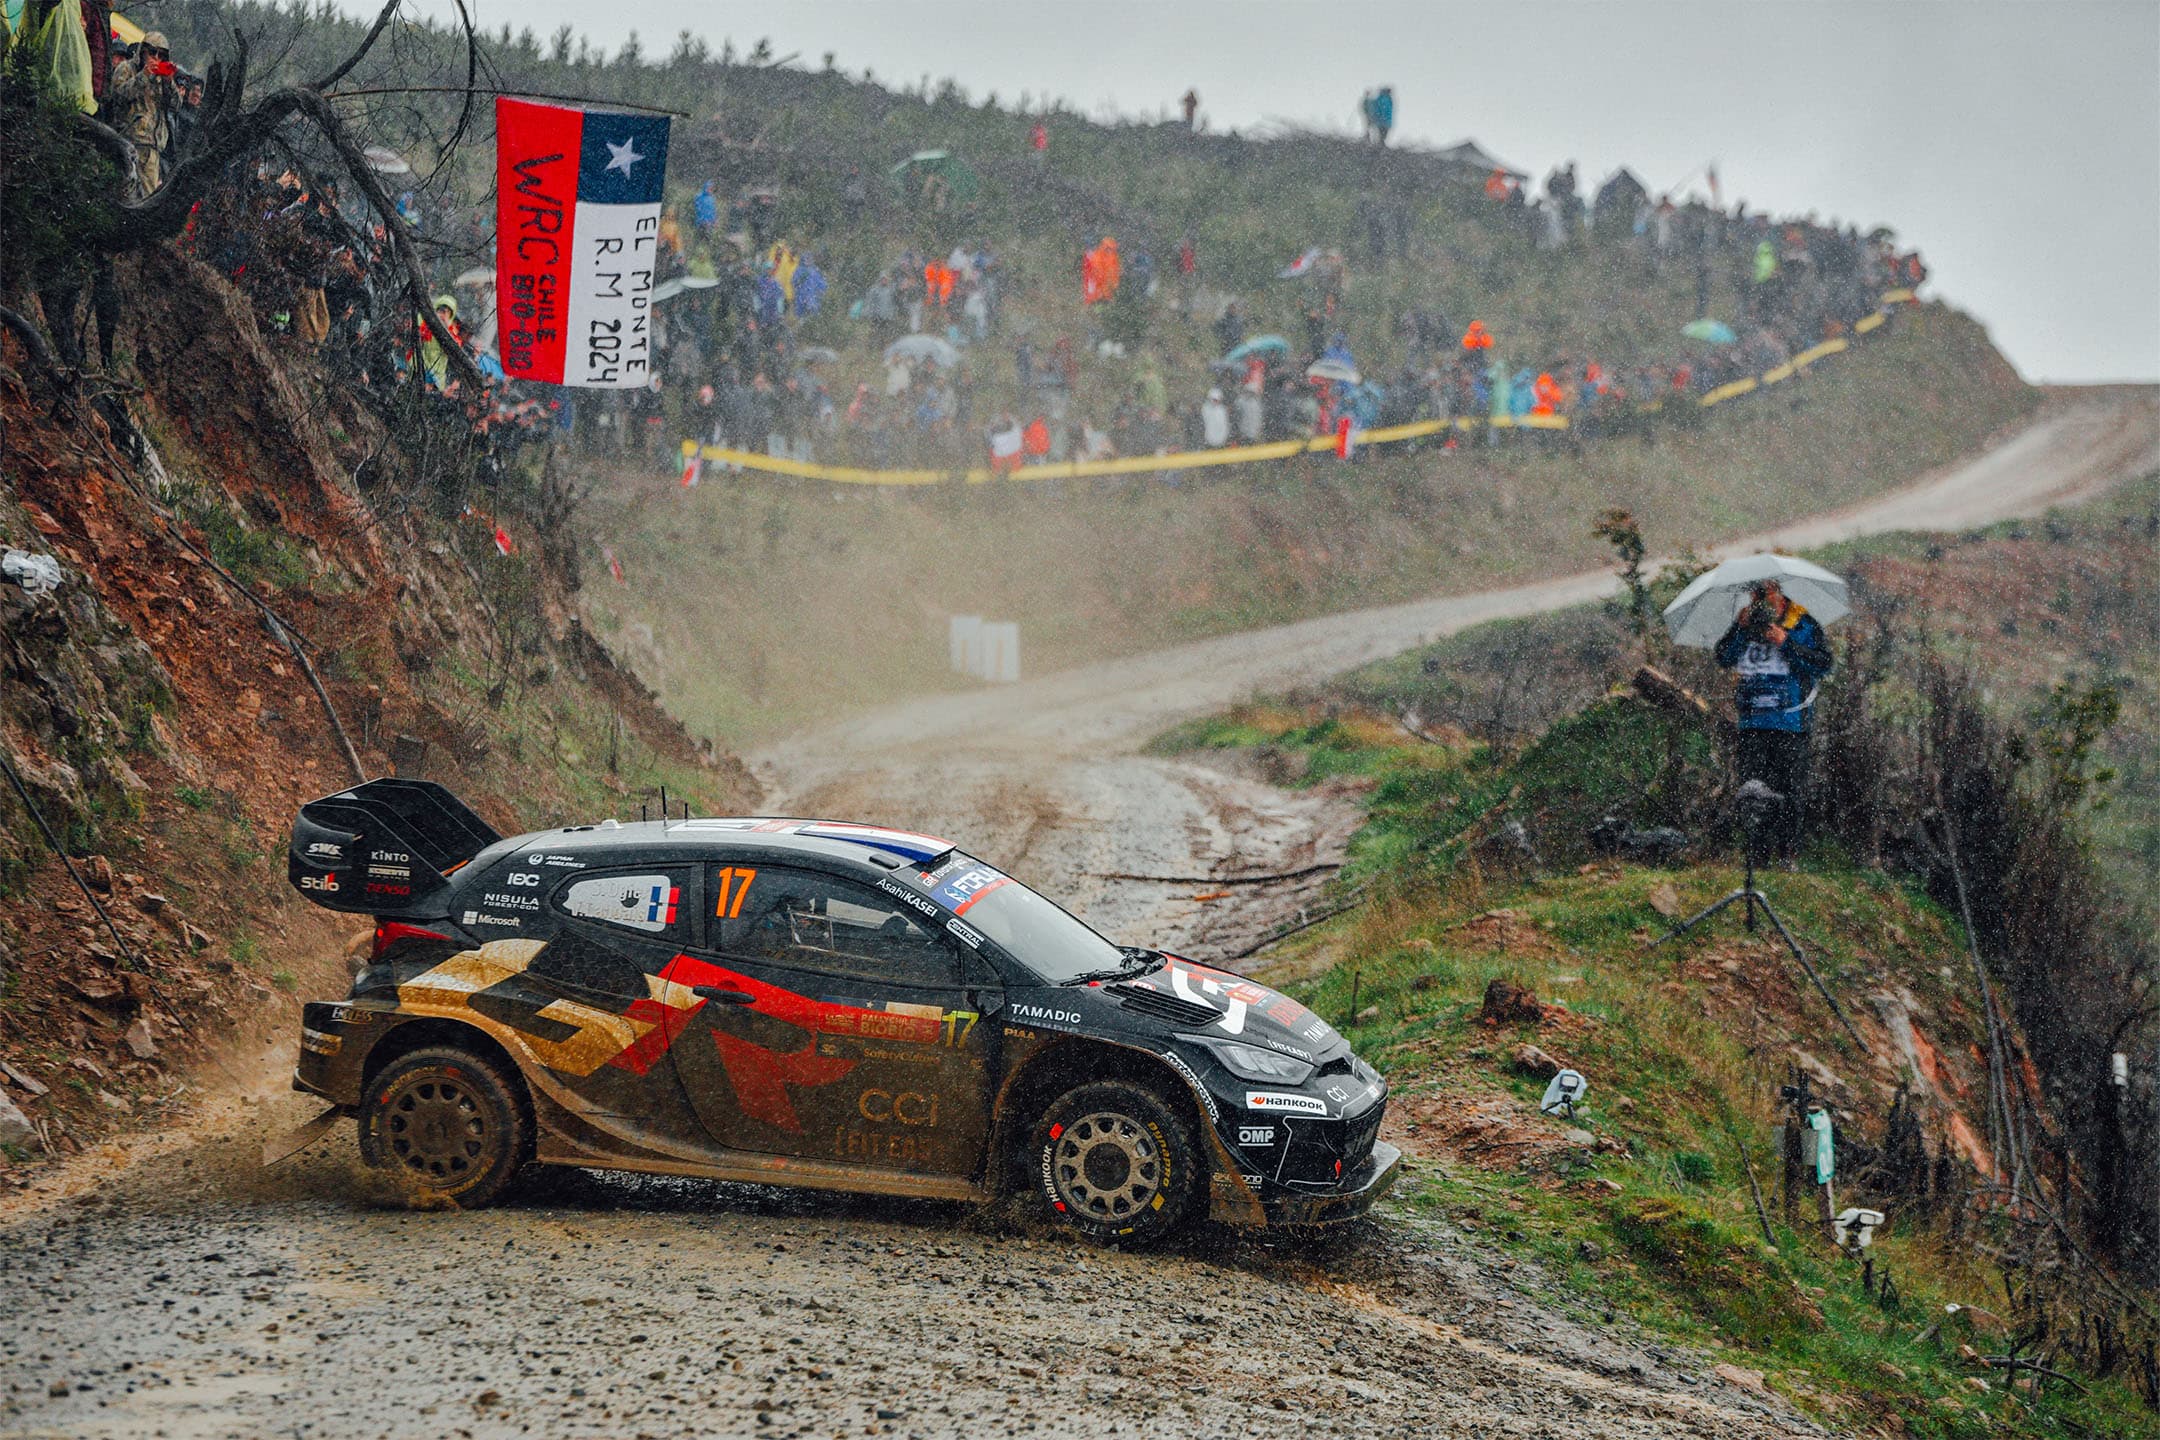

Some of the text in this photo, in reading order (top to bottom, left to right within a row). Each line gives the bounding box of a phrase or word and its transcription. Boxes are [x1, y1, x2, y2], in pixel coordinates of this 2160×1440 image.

[512, 153, 564, 266] WRC
[537, 274, 557, 344] CHILE
[626, 216, 657, 373] EL MONTE
[587, 319, 622, 384] 2024
[300, 872, 339, 892] Stilo
[544, 860, 586, 869] AIRLINES
[484, 893, 540, 906] NISULA
[716, 867, 757, 918] 17
[876, 878, 938, 918] AsahiKASEI
[478, 914, 521, 927] Microsoft
[942, 1010, 979, 1049] 17
[1011, 1003, 1081, 1024] TAMADIC
[1265, 1096, 1323, 1111] Hankook
[1239, 1131, 1274, 1144] OMP
[1041, 1145, 1060, 1202] Hankook
